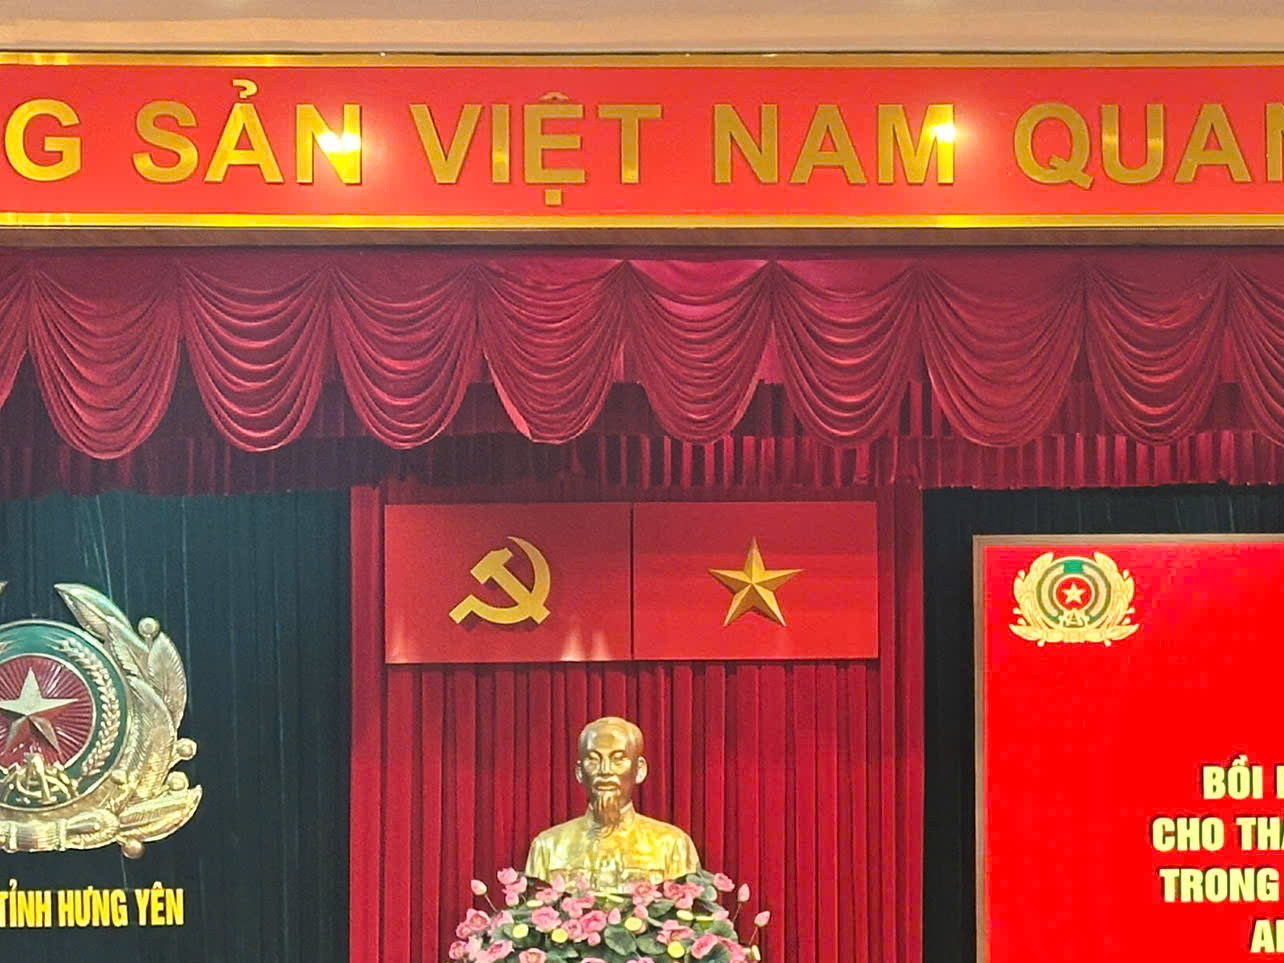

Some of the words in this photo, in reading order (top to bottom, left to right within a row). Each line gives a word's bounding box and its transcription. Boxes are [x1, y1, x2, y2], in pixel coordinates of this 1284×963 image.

[132, 78, 363, 185] SẢN
[408, 91, 663, 206] VIỆT
[714, 102, 957, 185] NAM
[1202, 755, 1265, 800] BỒI
[1152, 817, 1226, 854] CHO
[57, 885, 130, 928] HƯNG
[134, 881, 185, 926] YÊN
[1160, 868, 1281, 904] TRONG
